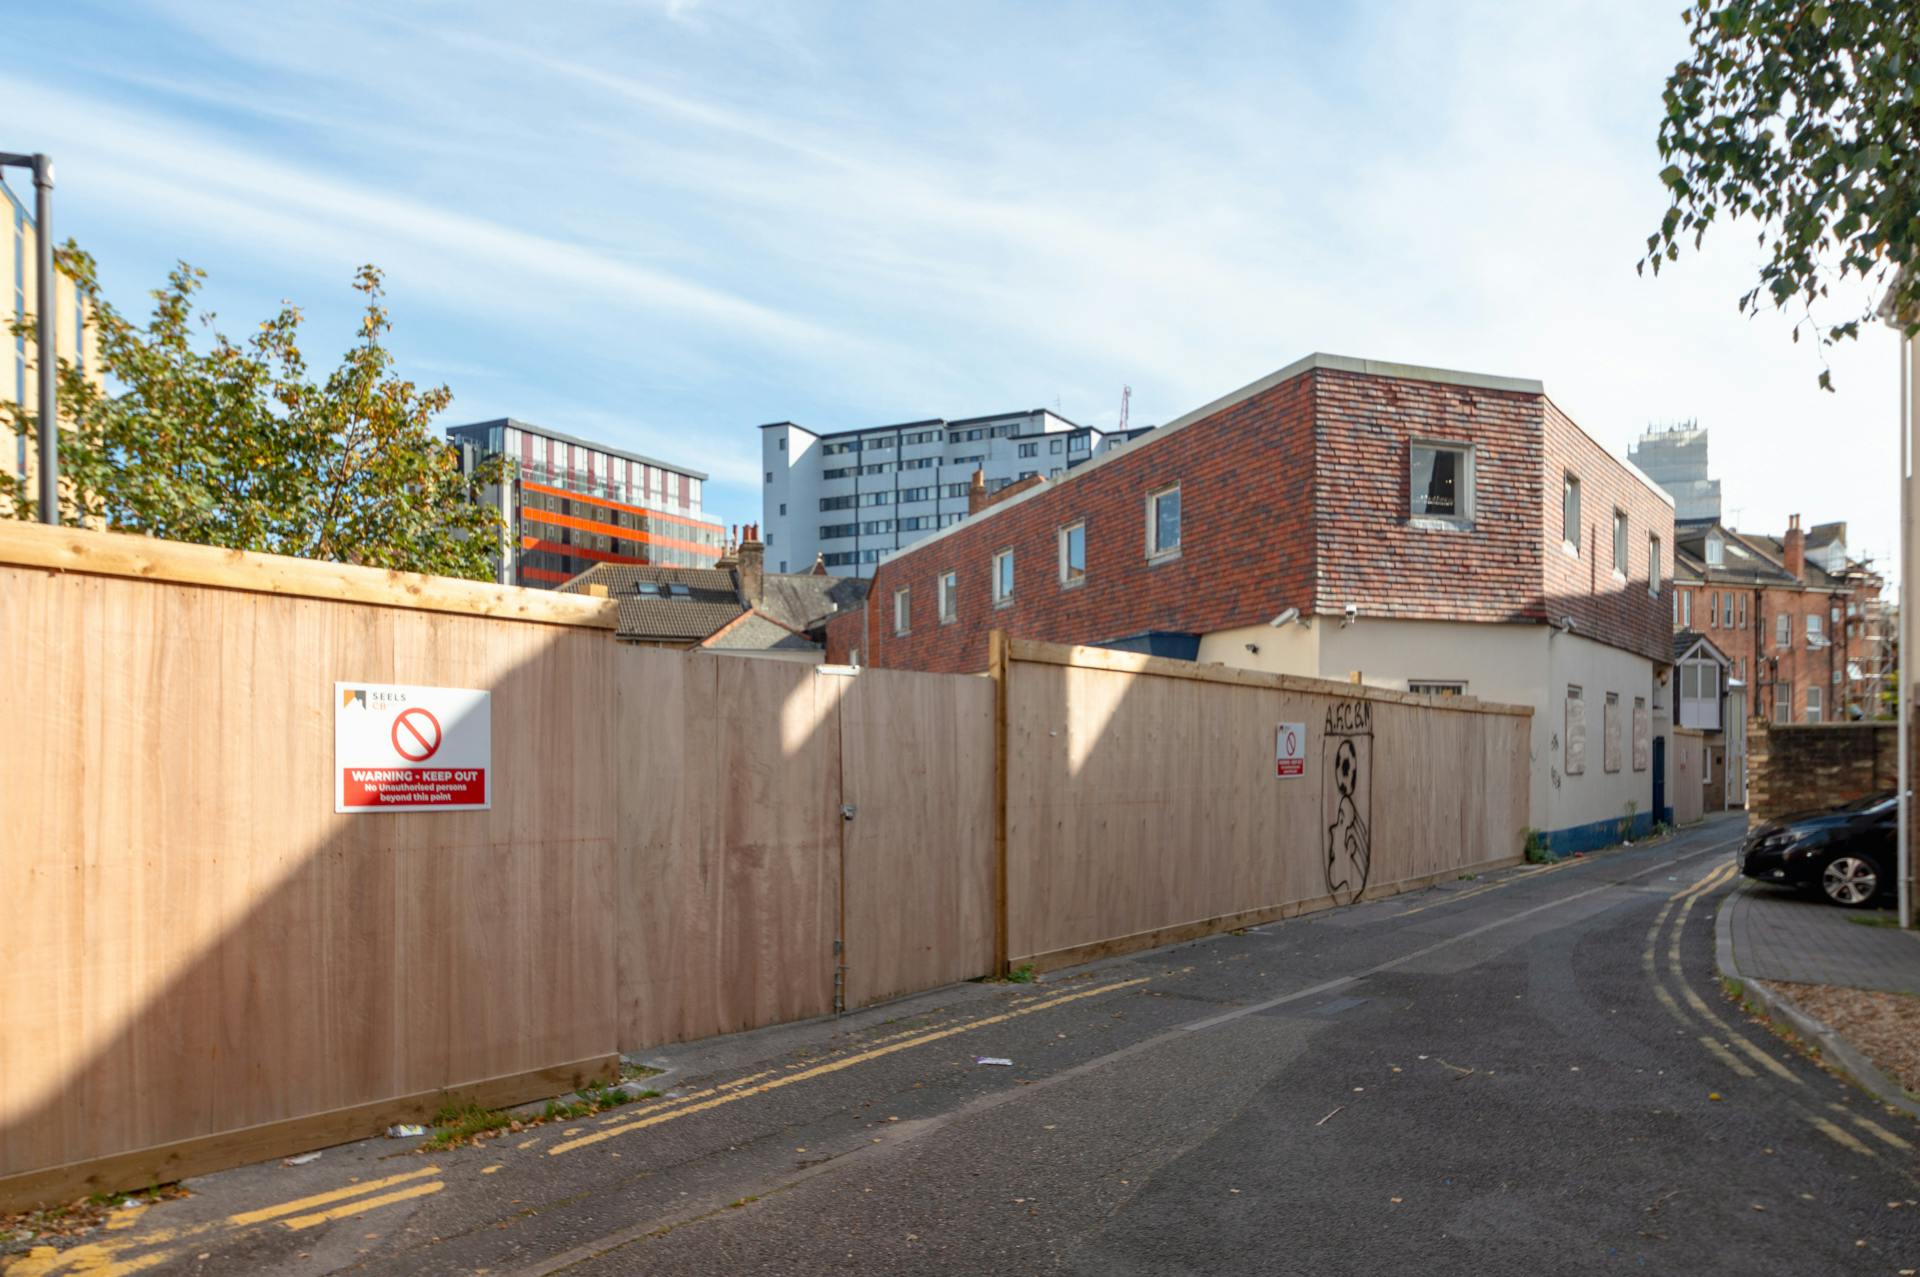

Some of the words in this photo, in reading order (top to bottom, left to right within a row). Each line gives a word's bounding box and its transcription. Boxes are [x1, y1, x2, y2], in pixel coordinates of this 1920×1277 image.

[372, 692, 406, 702] SEELS
[351, 770, 413, 782] WARNING
[423, 771, 452, 781] KEEP
[454, 771, 478, 782] OUT
[364, 783, 377, 792] No
[379, 783, 434, 792] Unauthorised
[435, 784, 467, 792] persons
[380, 793, 412, 802] beyond
[413, 792, 428, 801] this
[430, 792, 451, 802] point
